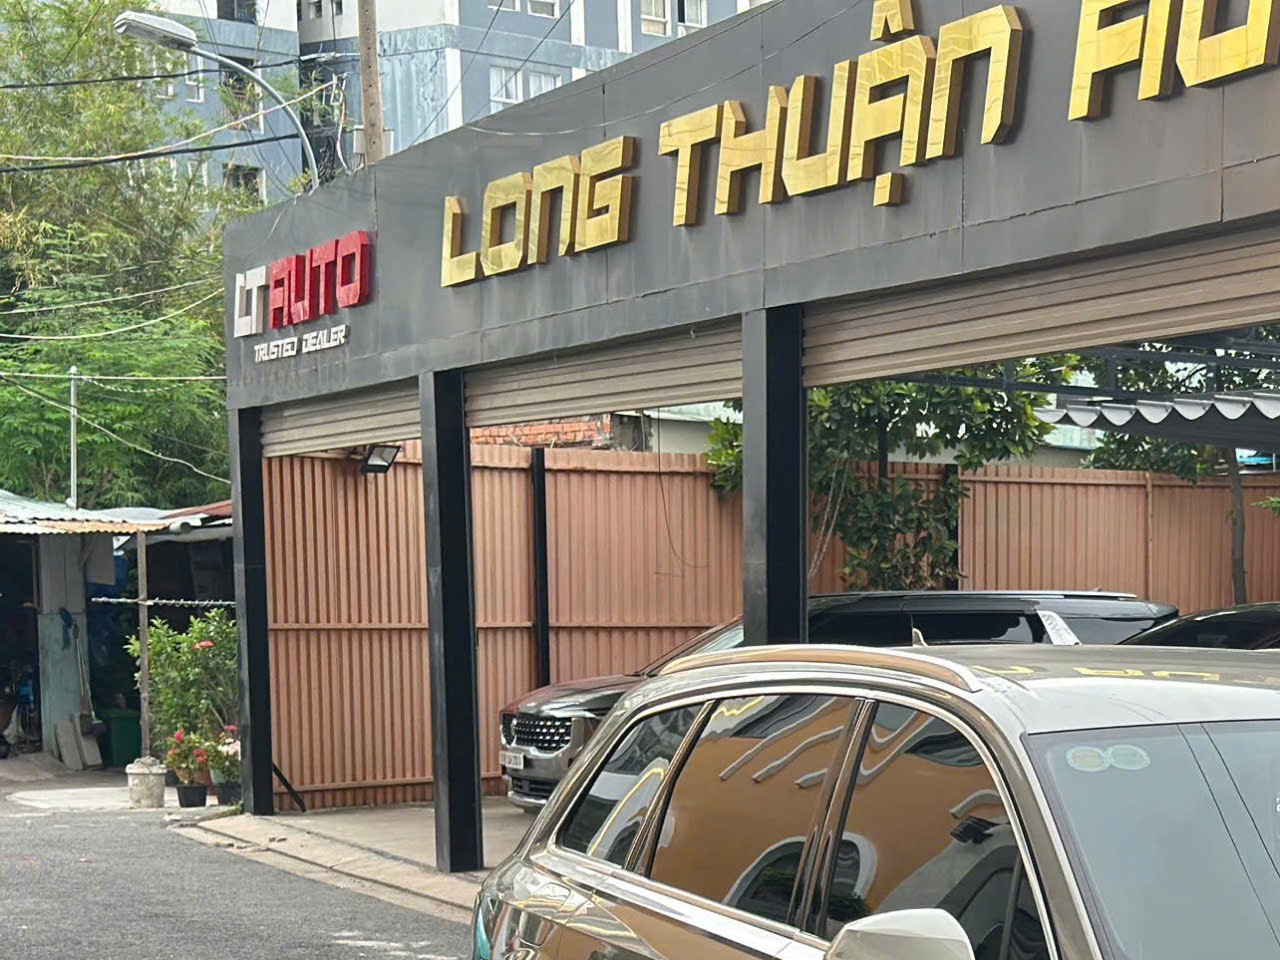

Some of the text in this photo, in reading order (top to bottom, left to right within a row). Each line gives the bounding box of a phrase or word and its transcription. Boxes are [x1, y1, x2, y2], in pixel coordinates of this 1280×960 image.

[440, 136, 635, 288] LONG
[658, 0, 1023, 226] THUẬN
[254, 324, 349, 363] TRUSTED DEALER
